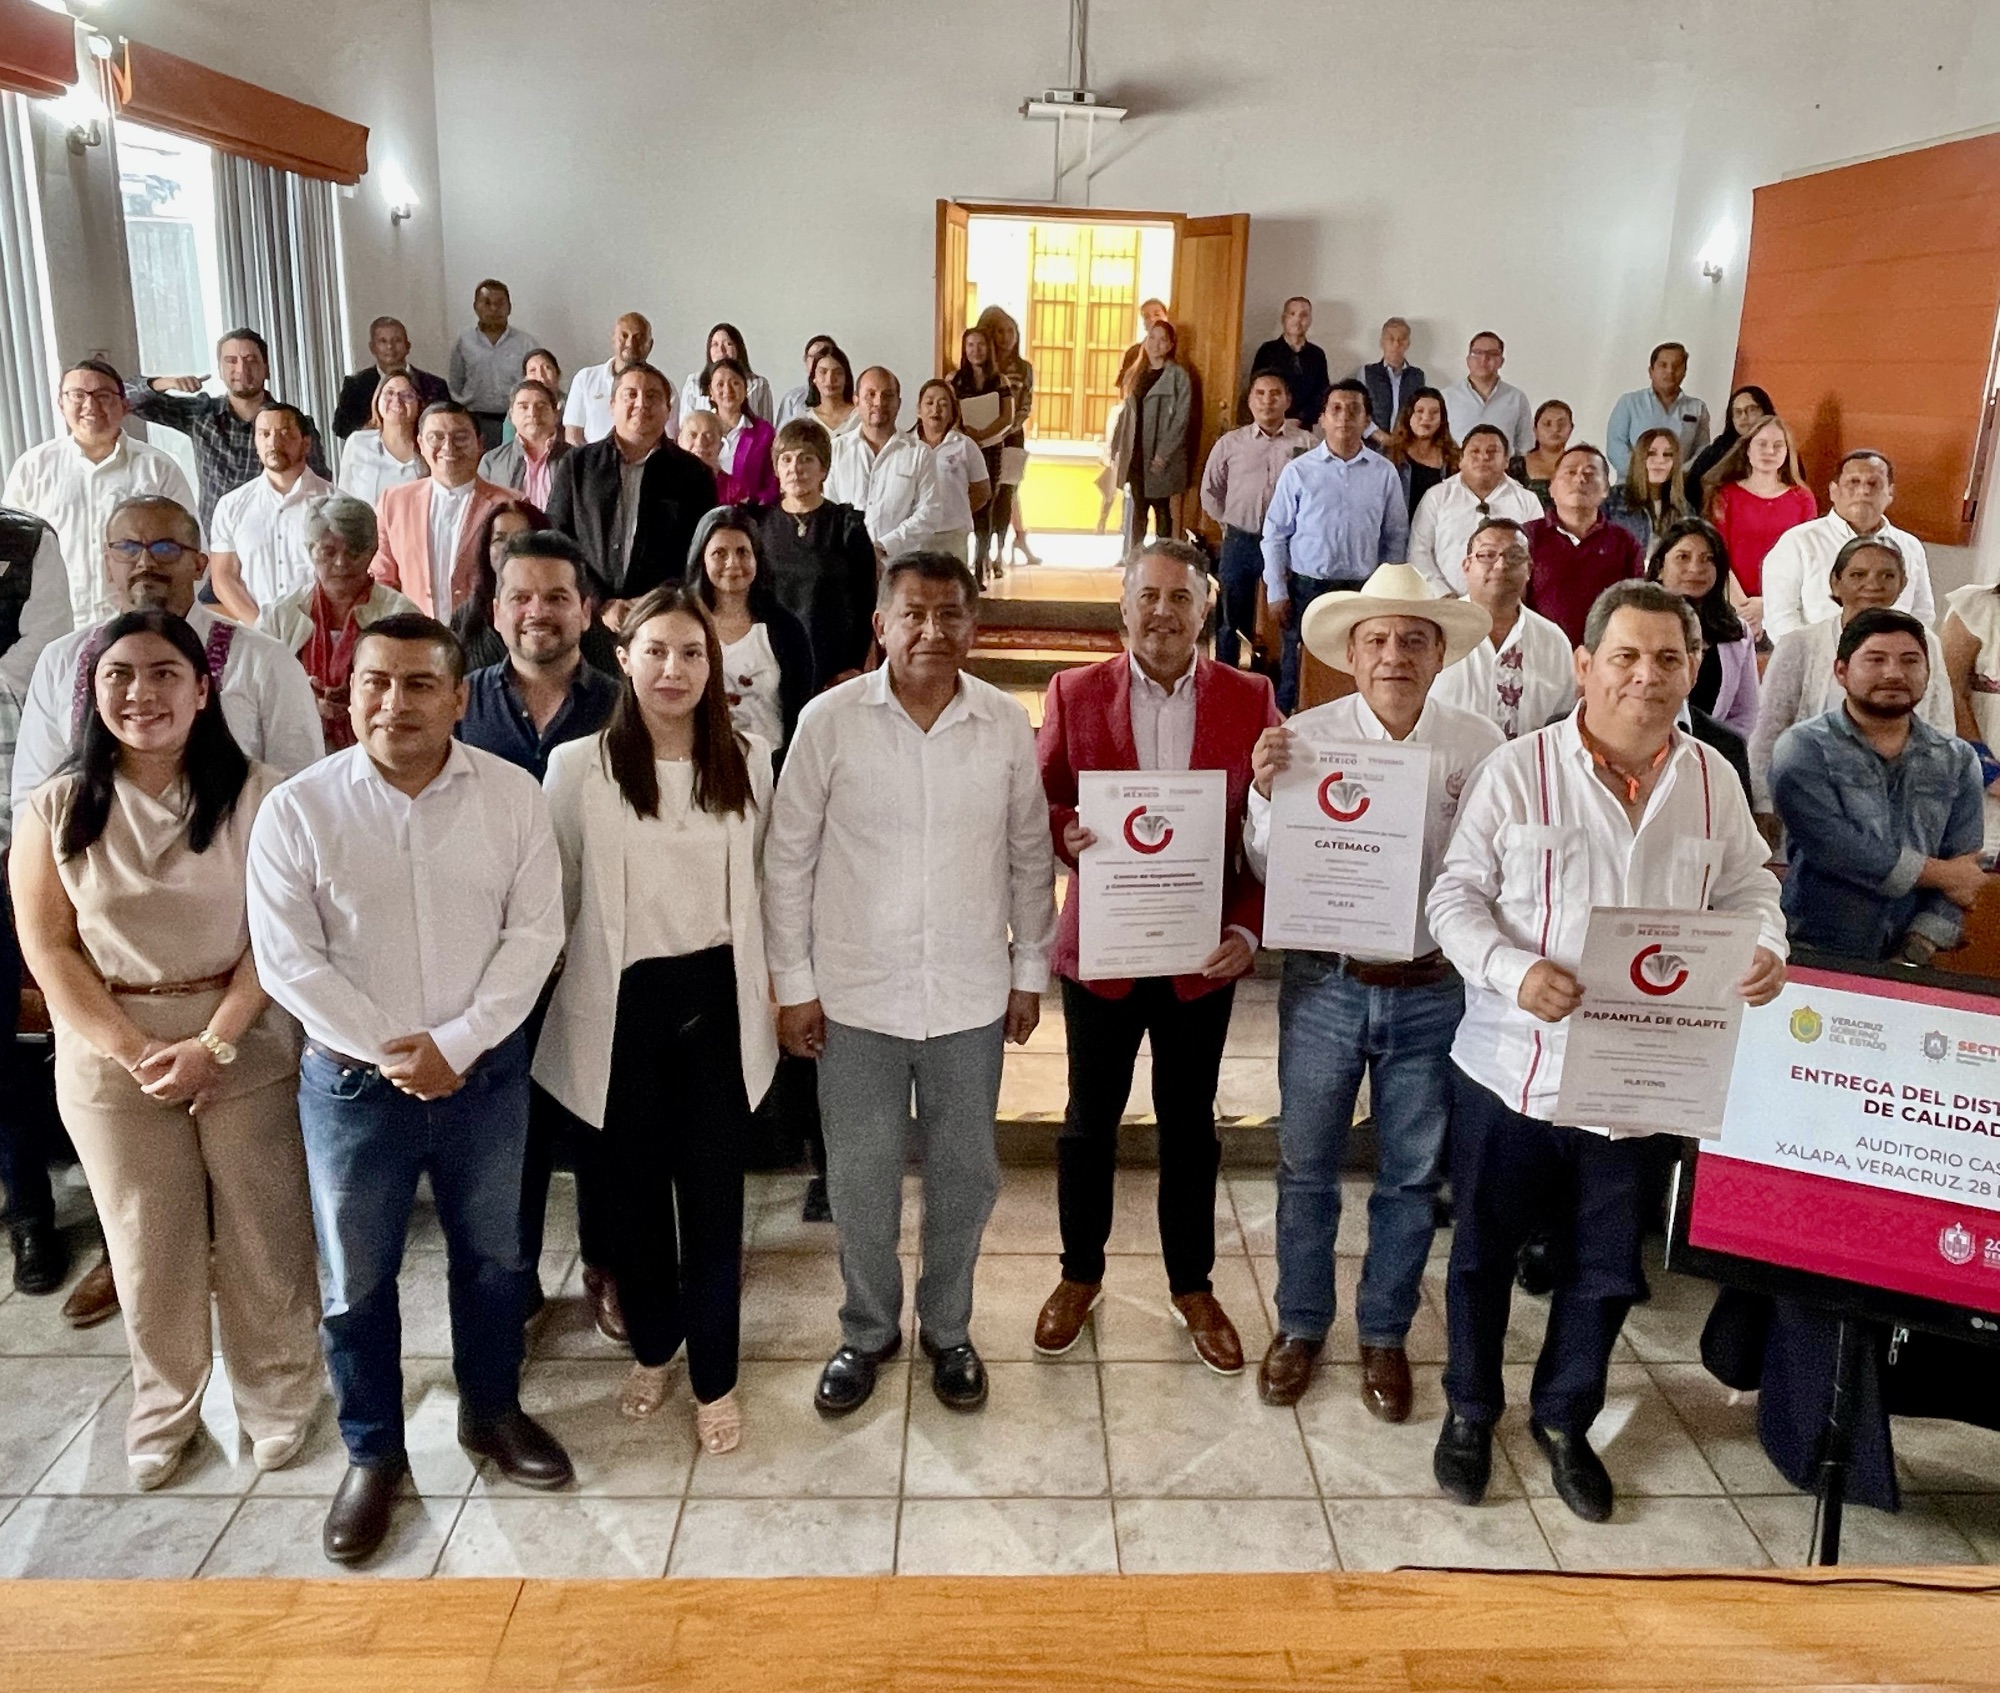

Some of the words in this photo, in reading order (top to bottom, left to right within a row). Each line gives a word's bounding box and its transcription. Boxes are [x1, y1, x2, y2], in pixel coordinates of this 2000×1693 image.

[1314, 839, 1381, 854] CATEMACO
[1583, 1010, 1652, 1024] PAPANTLA
[1655, 1015, 1673, 1026] DE
[1676, 1016, 1728, 1030] OLARTE
[1831, 1016, 1884, 1032] VERACRUZ
[1957, 1040, 2000, 1057] SECT
[1790, 1065, 1896, 1098] ENTREGA
[1902, 1084, 1946, 1107] DEL
[1863, 1099, 1895, 1118] DE
[1901, 1106, 2000, 1138] CALIDAD
[1855, 1136, 1963, 1168] AUDITORIO
[1775, 1141, 1851, 1171] XALAPA,
[1967, 1179, 1992, 1196] 28
